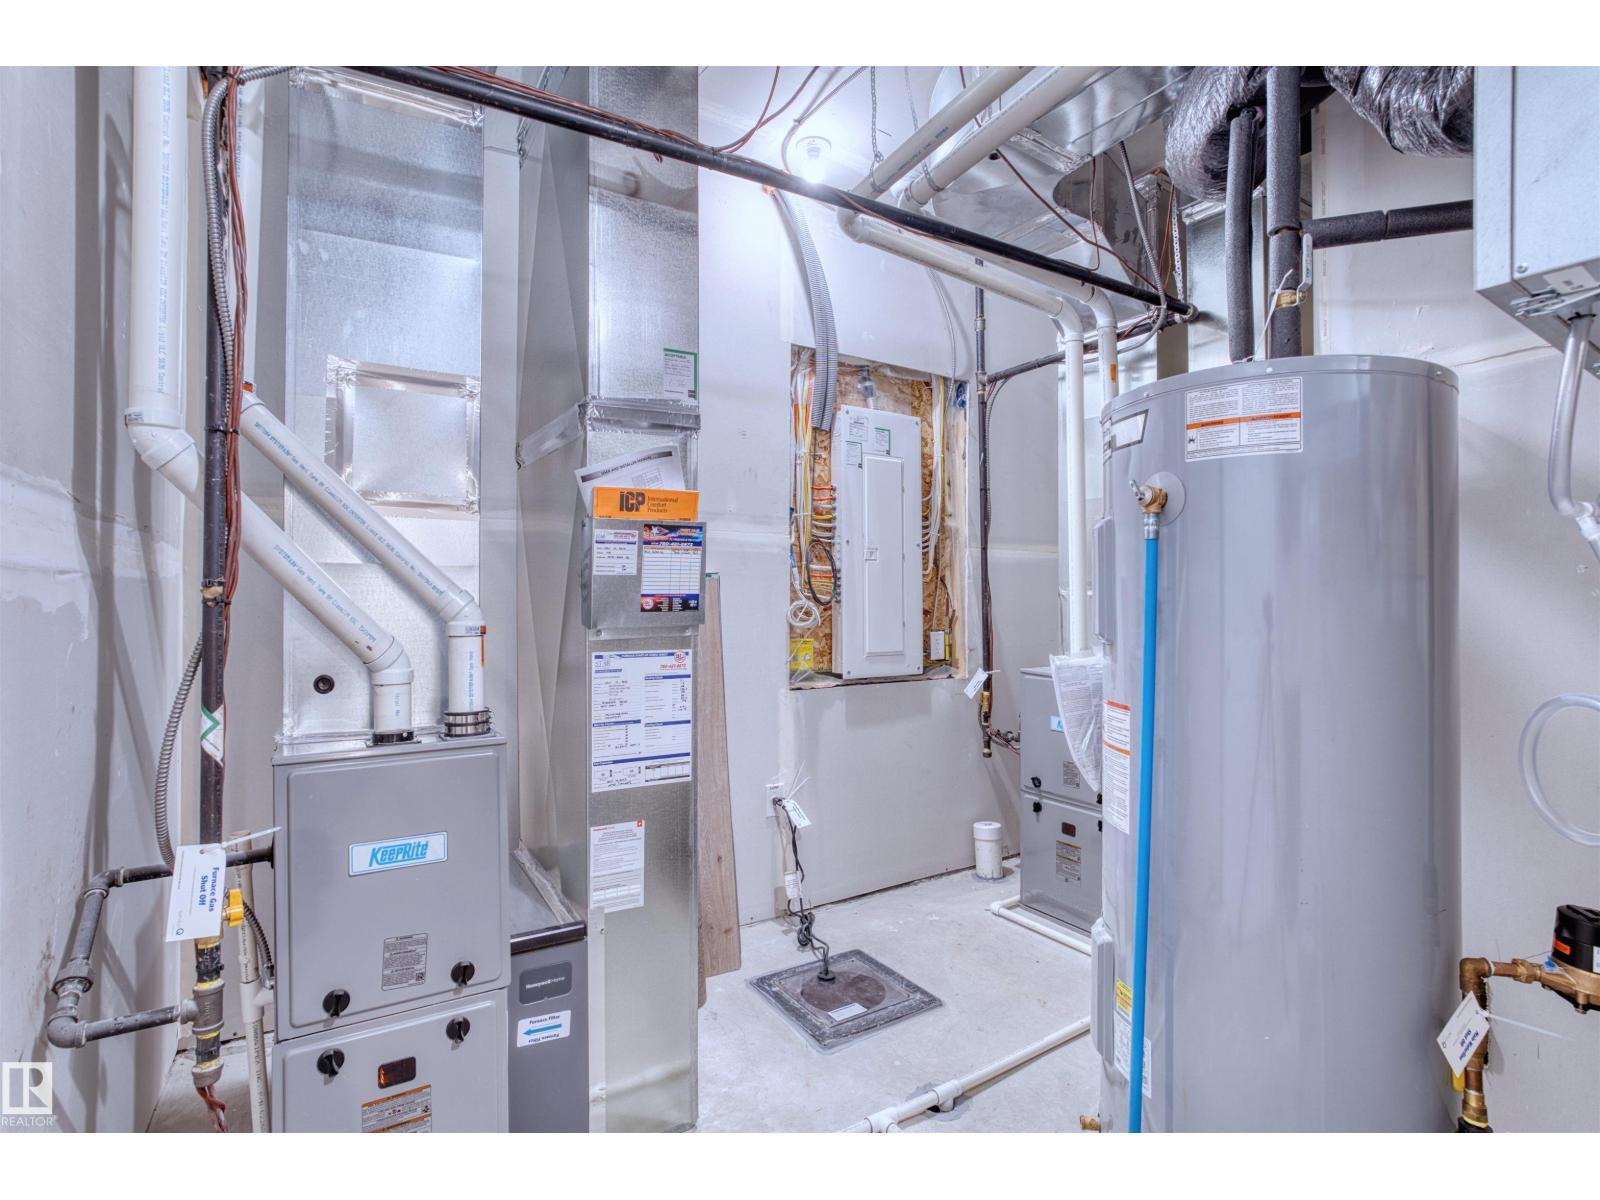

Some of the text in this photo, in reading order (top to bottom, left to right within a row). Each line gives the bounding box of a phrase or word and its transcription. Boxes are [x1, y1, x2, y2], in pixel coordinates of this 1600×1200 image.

[368, 841, 429, 867] KeepRite
[198, 875, 208, 906] Shut Off
[209, 867, 220, 912] Furnace Gas
